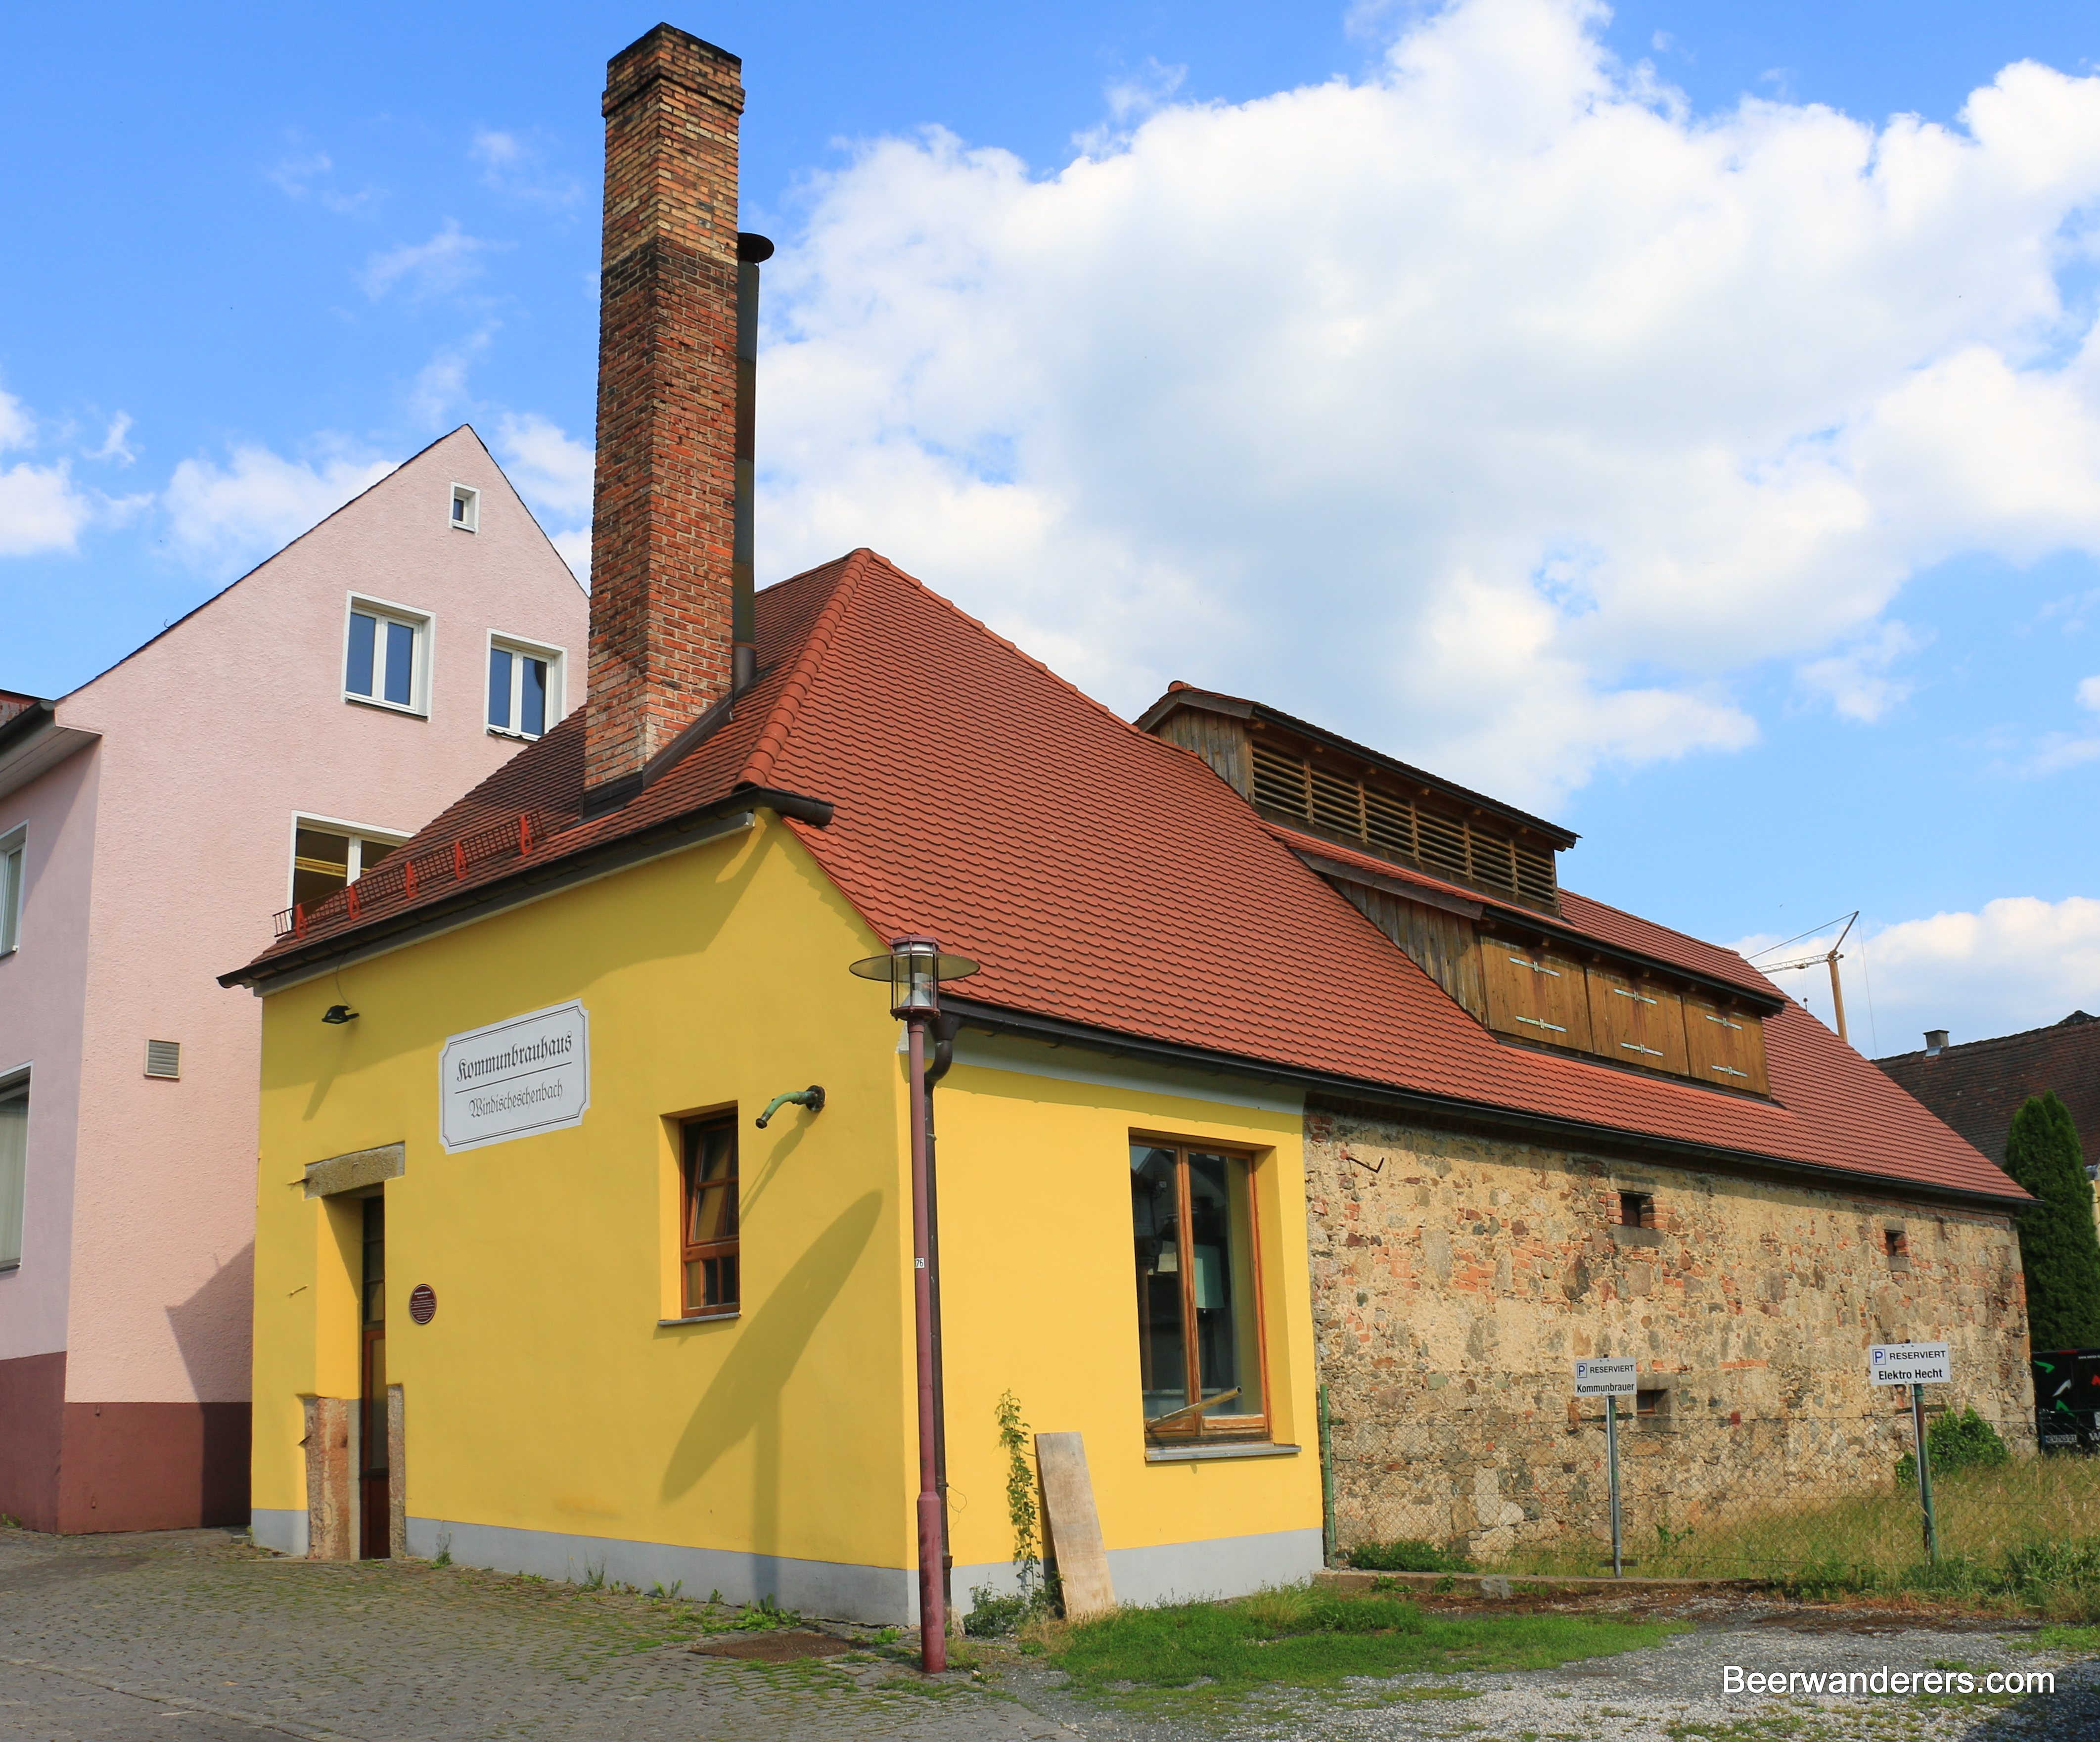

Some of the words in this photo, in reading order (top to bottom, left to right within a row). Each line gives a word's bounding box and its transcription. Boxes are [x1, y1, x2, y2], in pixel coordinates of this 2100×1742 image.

[457, 1030, 572, 1082] Kommunbrauhaus
[469, 1078, 563, 1117] Windischeschenbach
[914, 1259, 924, 1267] 76
[1889, 1350, 1946, 1360] RESERVIERT
[1590, 1365, 1634, 1374] RESERVIERT
[1878, 1370, 1912, 1380] Elektro
[1915, 1368, 1943, 1379] Hecht
[1577, 1382, 1635, 1393] Kommunbrauer
